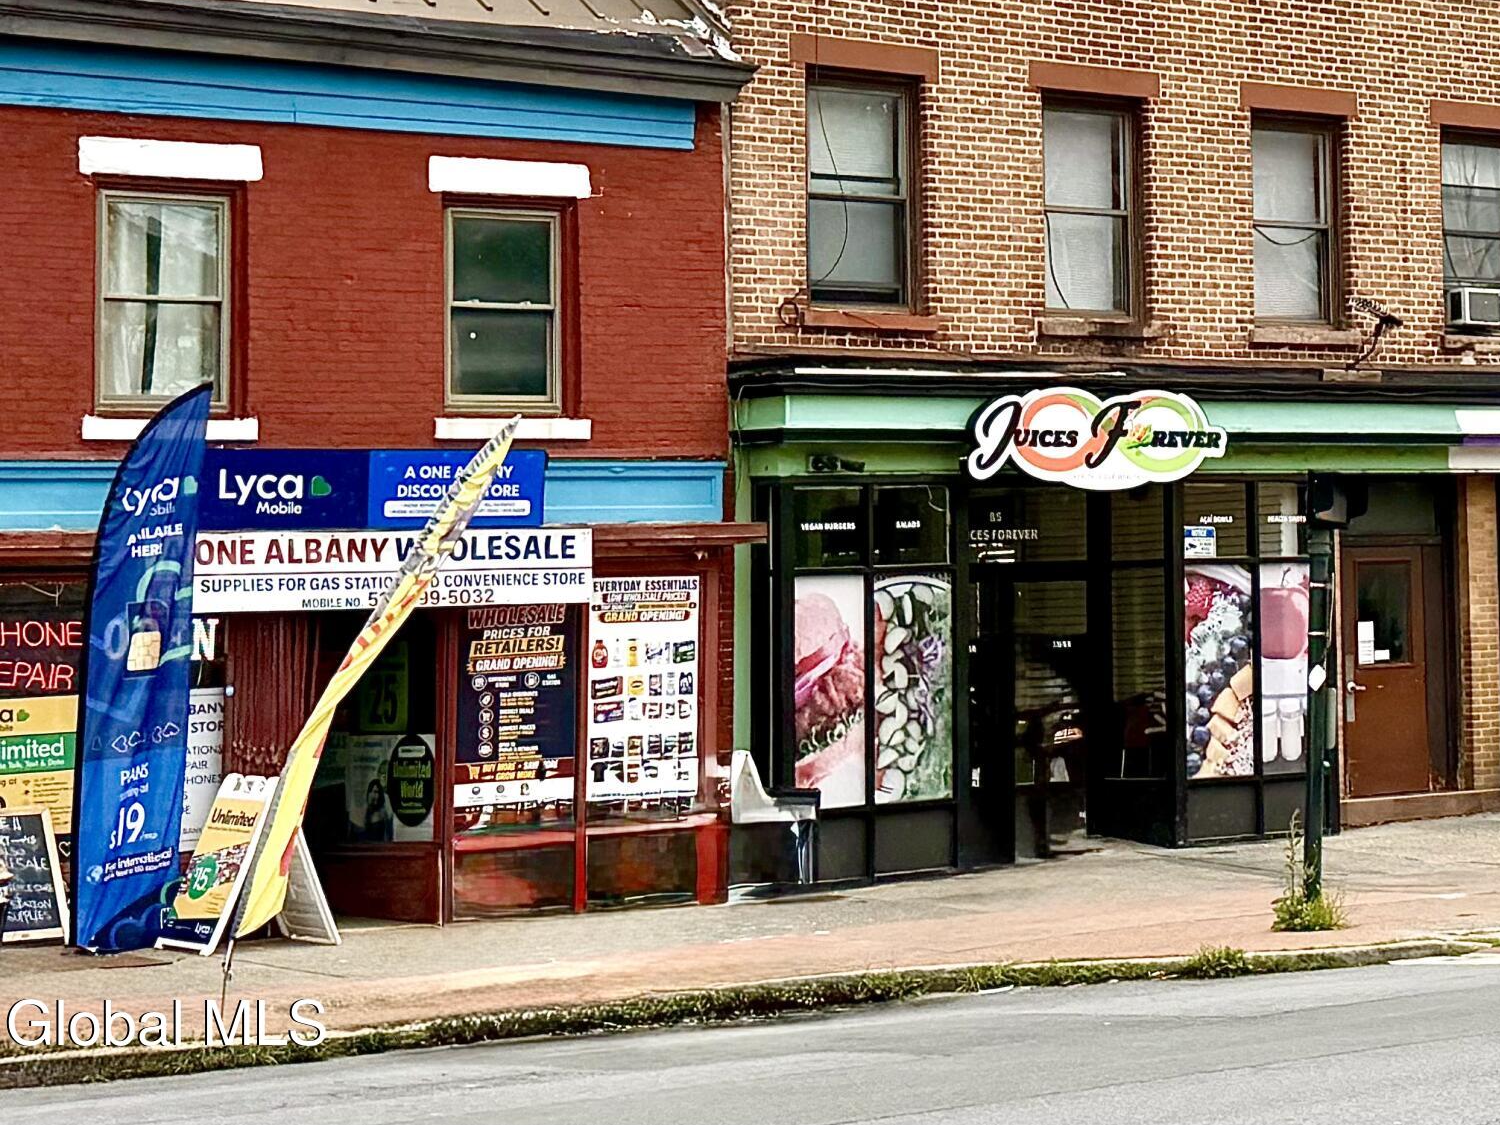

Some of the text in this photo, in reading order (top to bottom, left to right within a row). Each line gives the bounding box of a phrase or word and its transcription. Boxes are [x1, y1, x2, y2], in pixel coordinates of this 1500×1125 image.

[975, 400, 1079, 471] JUICES
[404, 465, 514, 479] A ONE ANY
[218, 468, 304, 506] Lyca
[397, 484, 520, 498] DISCOU TORE
[255, 501, 303, 515] Mobile
[195, 534, 576, 566] ONE ALBANY WOLESALE
[200, 578, 274, 593] SUPPLIES
[278, 577, 306, 592] FOR
[309, 577, 340, 591] GAS
[344, 576, 395, 590] STATIO
[443, 574, 539, 588] CONVENIENCE
[542, 572, 586, 586] STORE
[593, 579, 698, 592] EVERYDAY ESSENTIALS
[301, 597, 342, 608] MOBILE
[467, 603, 567, 629] WHOLESALE
[604, 612, 638, 622] GRAND
[0, 620, 83, 647] HONE
[482, 626, 551, 640] PRICES FOR
[473, 637, 560, 655] RETAILERS!
[475, 656, 558, 672] GRAND OPENING!
[0, 661, 74, 690] EPAIR
[189, 702, 224, 716] BANY
[191, 720, 224, 734] STOR
[1, 736, 64, 760] imited
